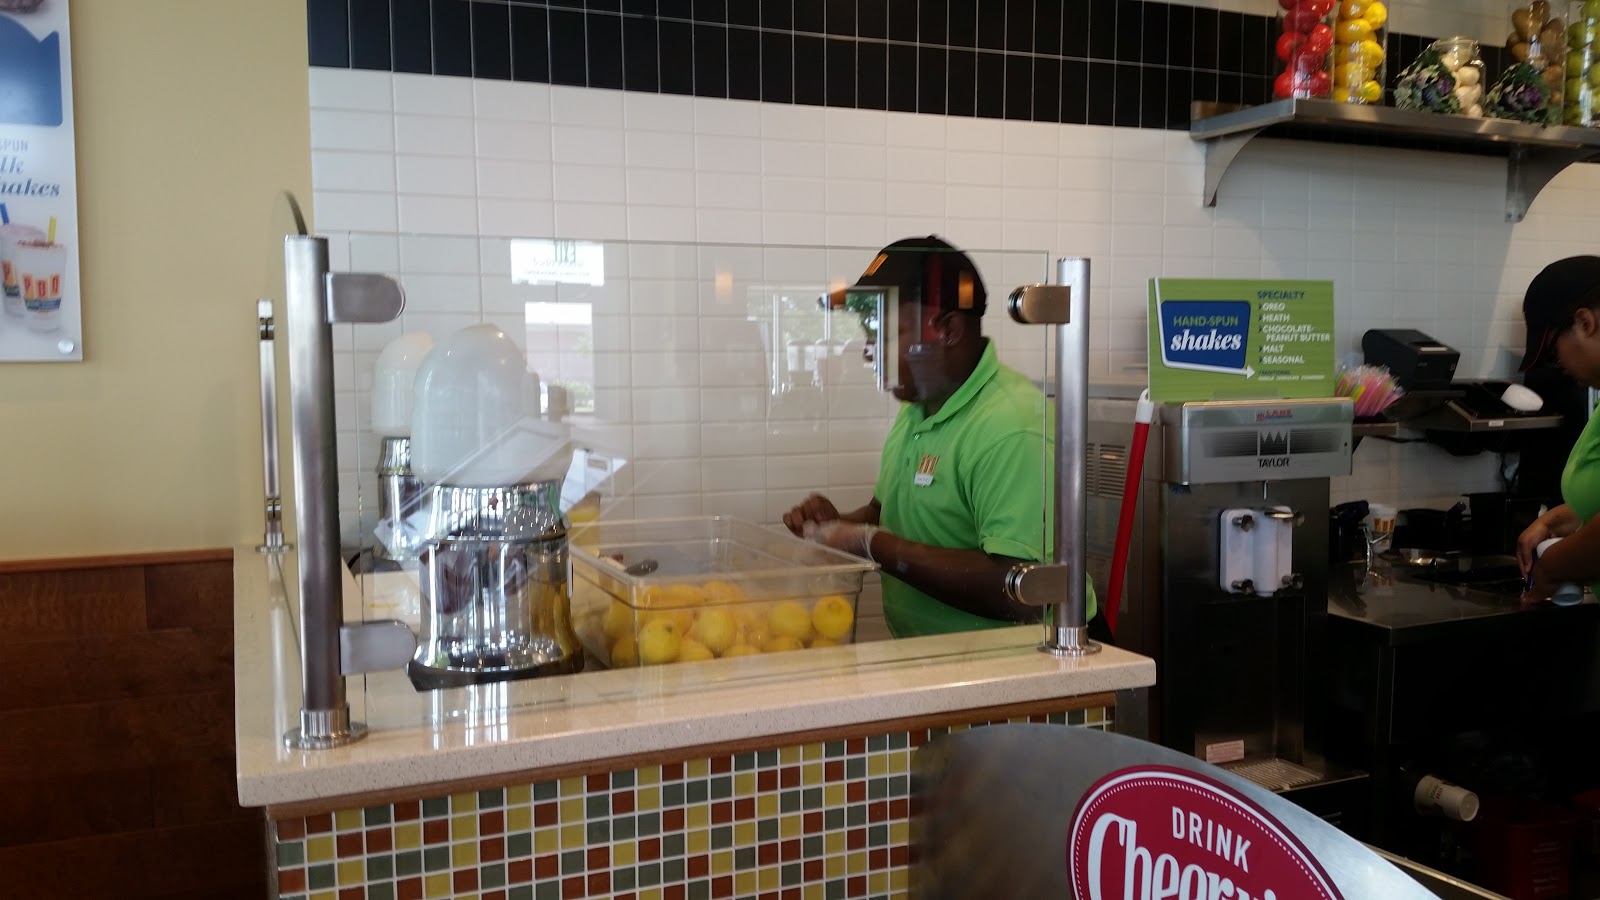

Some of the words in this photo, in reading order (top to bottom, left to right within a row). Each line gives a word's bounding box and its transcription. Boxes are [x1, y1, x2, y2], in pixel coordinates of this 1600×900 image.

[1257, 290, 1305, 299] SPECIALTY
[1262, 302, 1286, 311] OREO
[1173, 315, 1239, 327] HAND-SPUN
[1262, 313, 1290, 322] HEATH
[1170, 328, 1242, 351] shakes
[1266, 333, 1298, 342] PEANUT
[1300, 333, 1330, 342] BUTTER
[1262, 344, 1284, 353] MALT
[1262, 355, 1305, 364] SEASONAL
[1258, 457, 1290, 469] TAYLOR
[1172, 806, 1252, 873] DRINK
